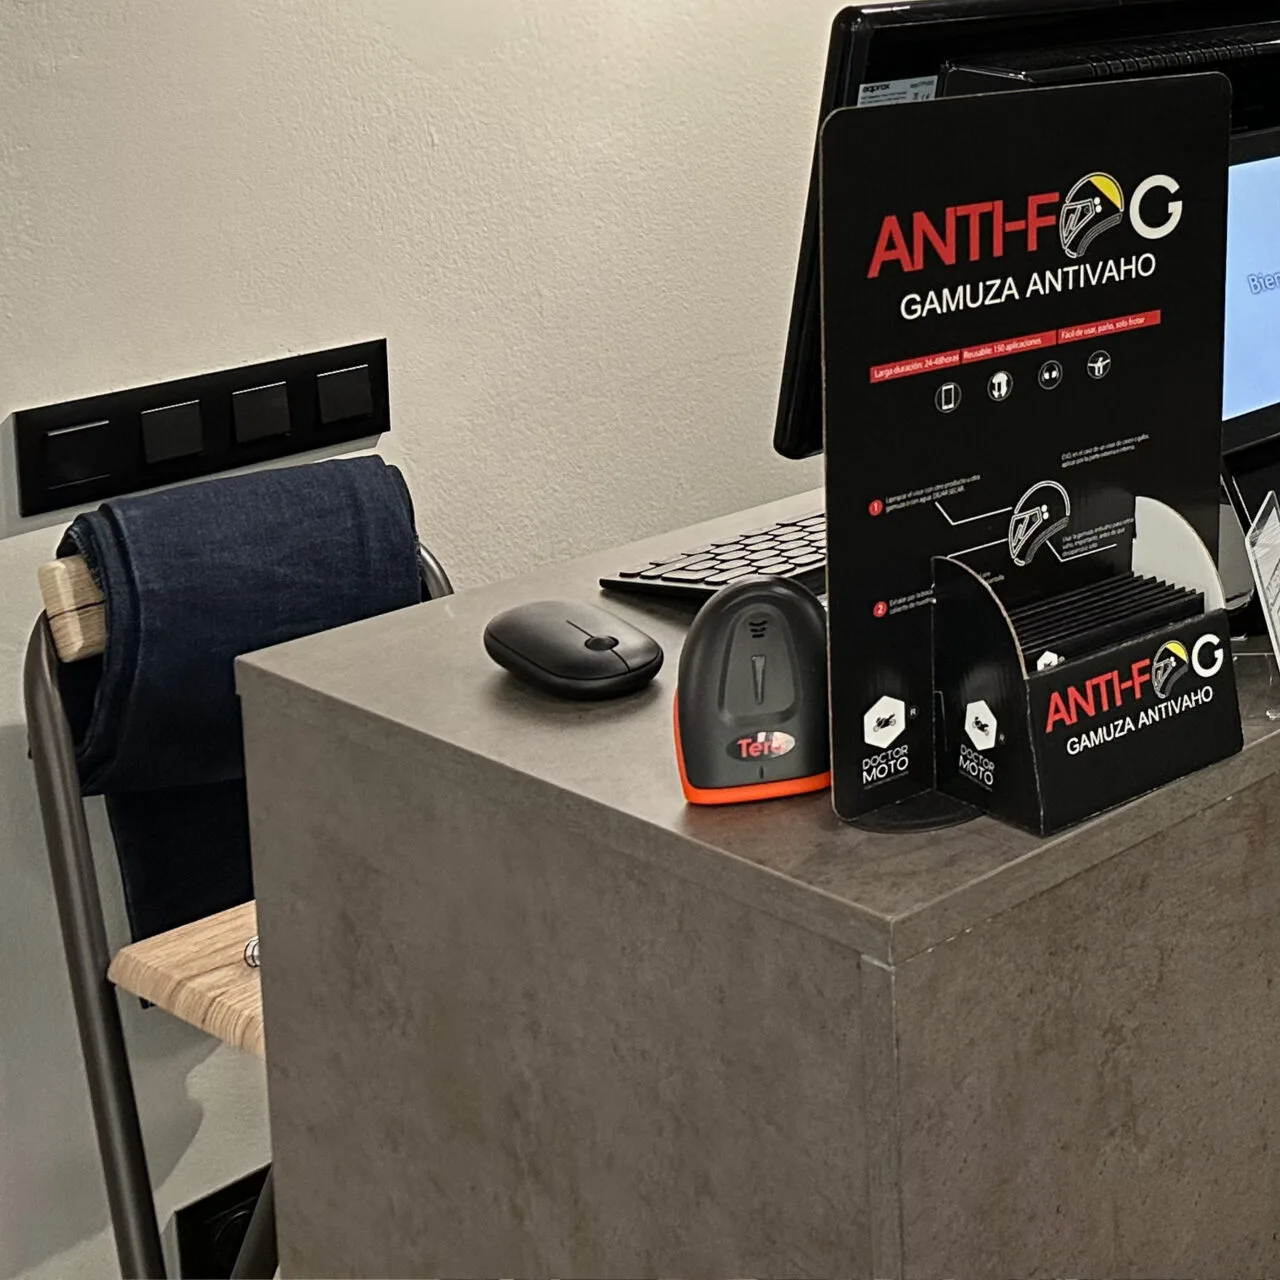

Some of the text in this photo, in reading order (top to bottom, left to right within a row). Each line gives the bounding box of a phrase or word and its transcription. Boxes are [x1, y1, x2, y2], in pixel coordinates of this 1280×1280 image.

[900, 252, 1156, 321] GAMUZA ANTIVAHO
[1066, 685, 1214, 756] GAMUZA ANTIVAHO
[861, 744, 909, 770] DOCTOR
[862, 756, 909, 785] MOTO
[958, 754, 994, 786] MOTO
[960, 743, 996, 773] DOCTOR
